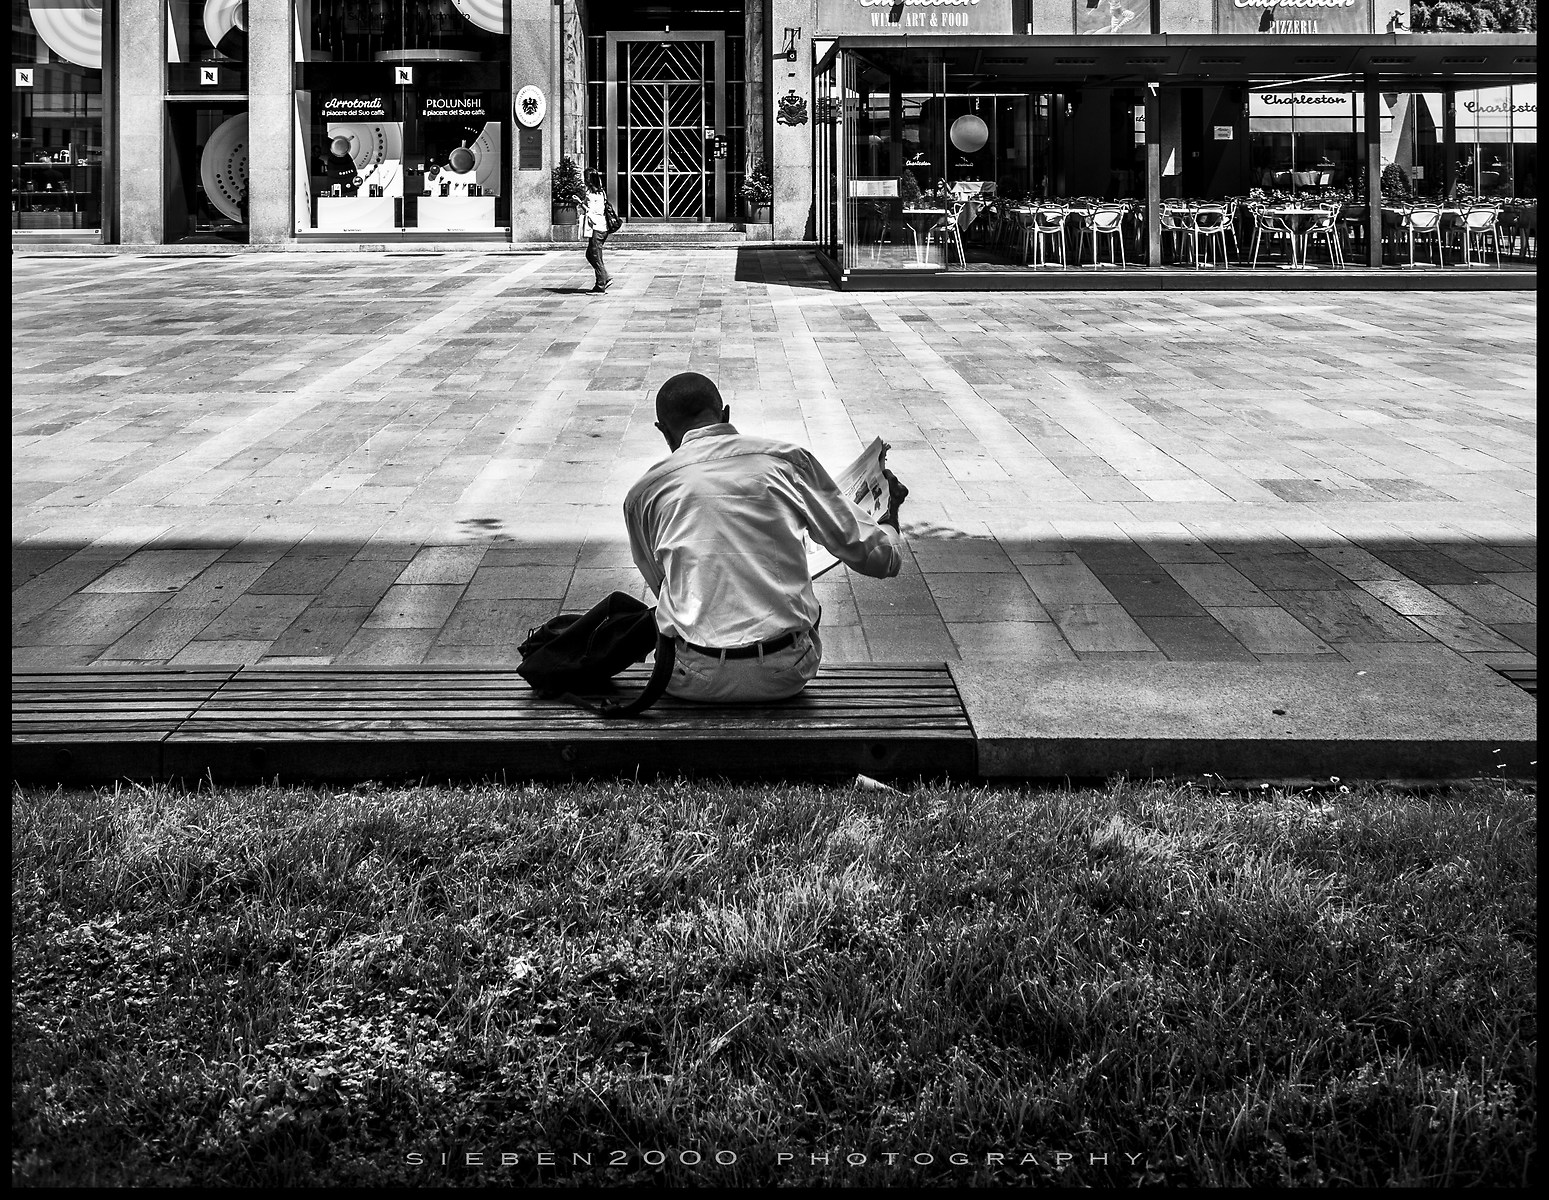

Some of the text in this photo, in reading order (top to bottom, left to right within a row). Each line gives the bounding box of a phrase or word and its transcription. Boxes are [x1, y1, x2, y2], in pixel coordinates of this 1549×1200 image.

[905, 12, 926, 27] ART
[929, 12, 938, 27] &
[941, 12, 969, 27] FOOD
[1269, 20, 1319, 34] PIZZERIA
[325, 98, 382, 108] Arrotondi
[1260, 94, 1347, 105] Charleston
